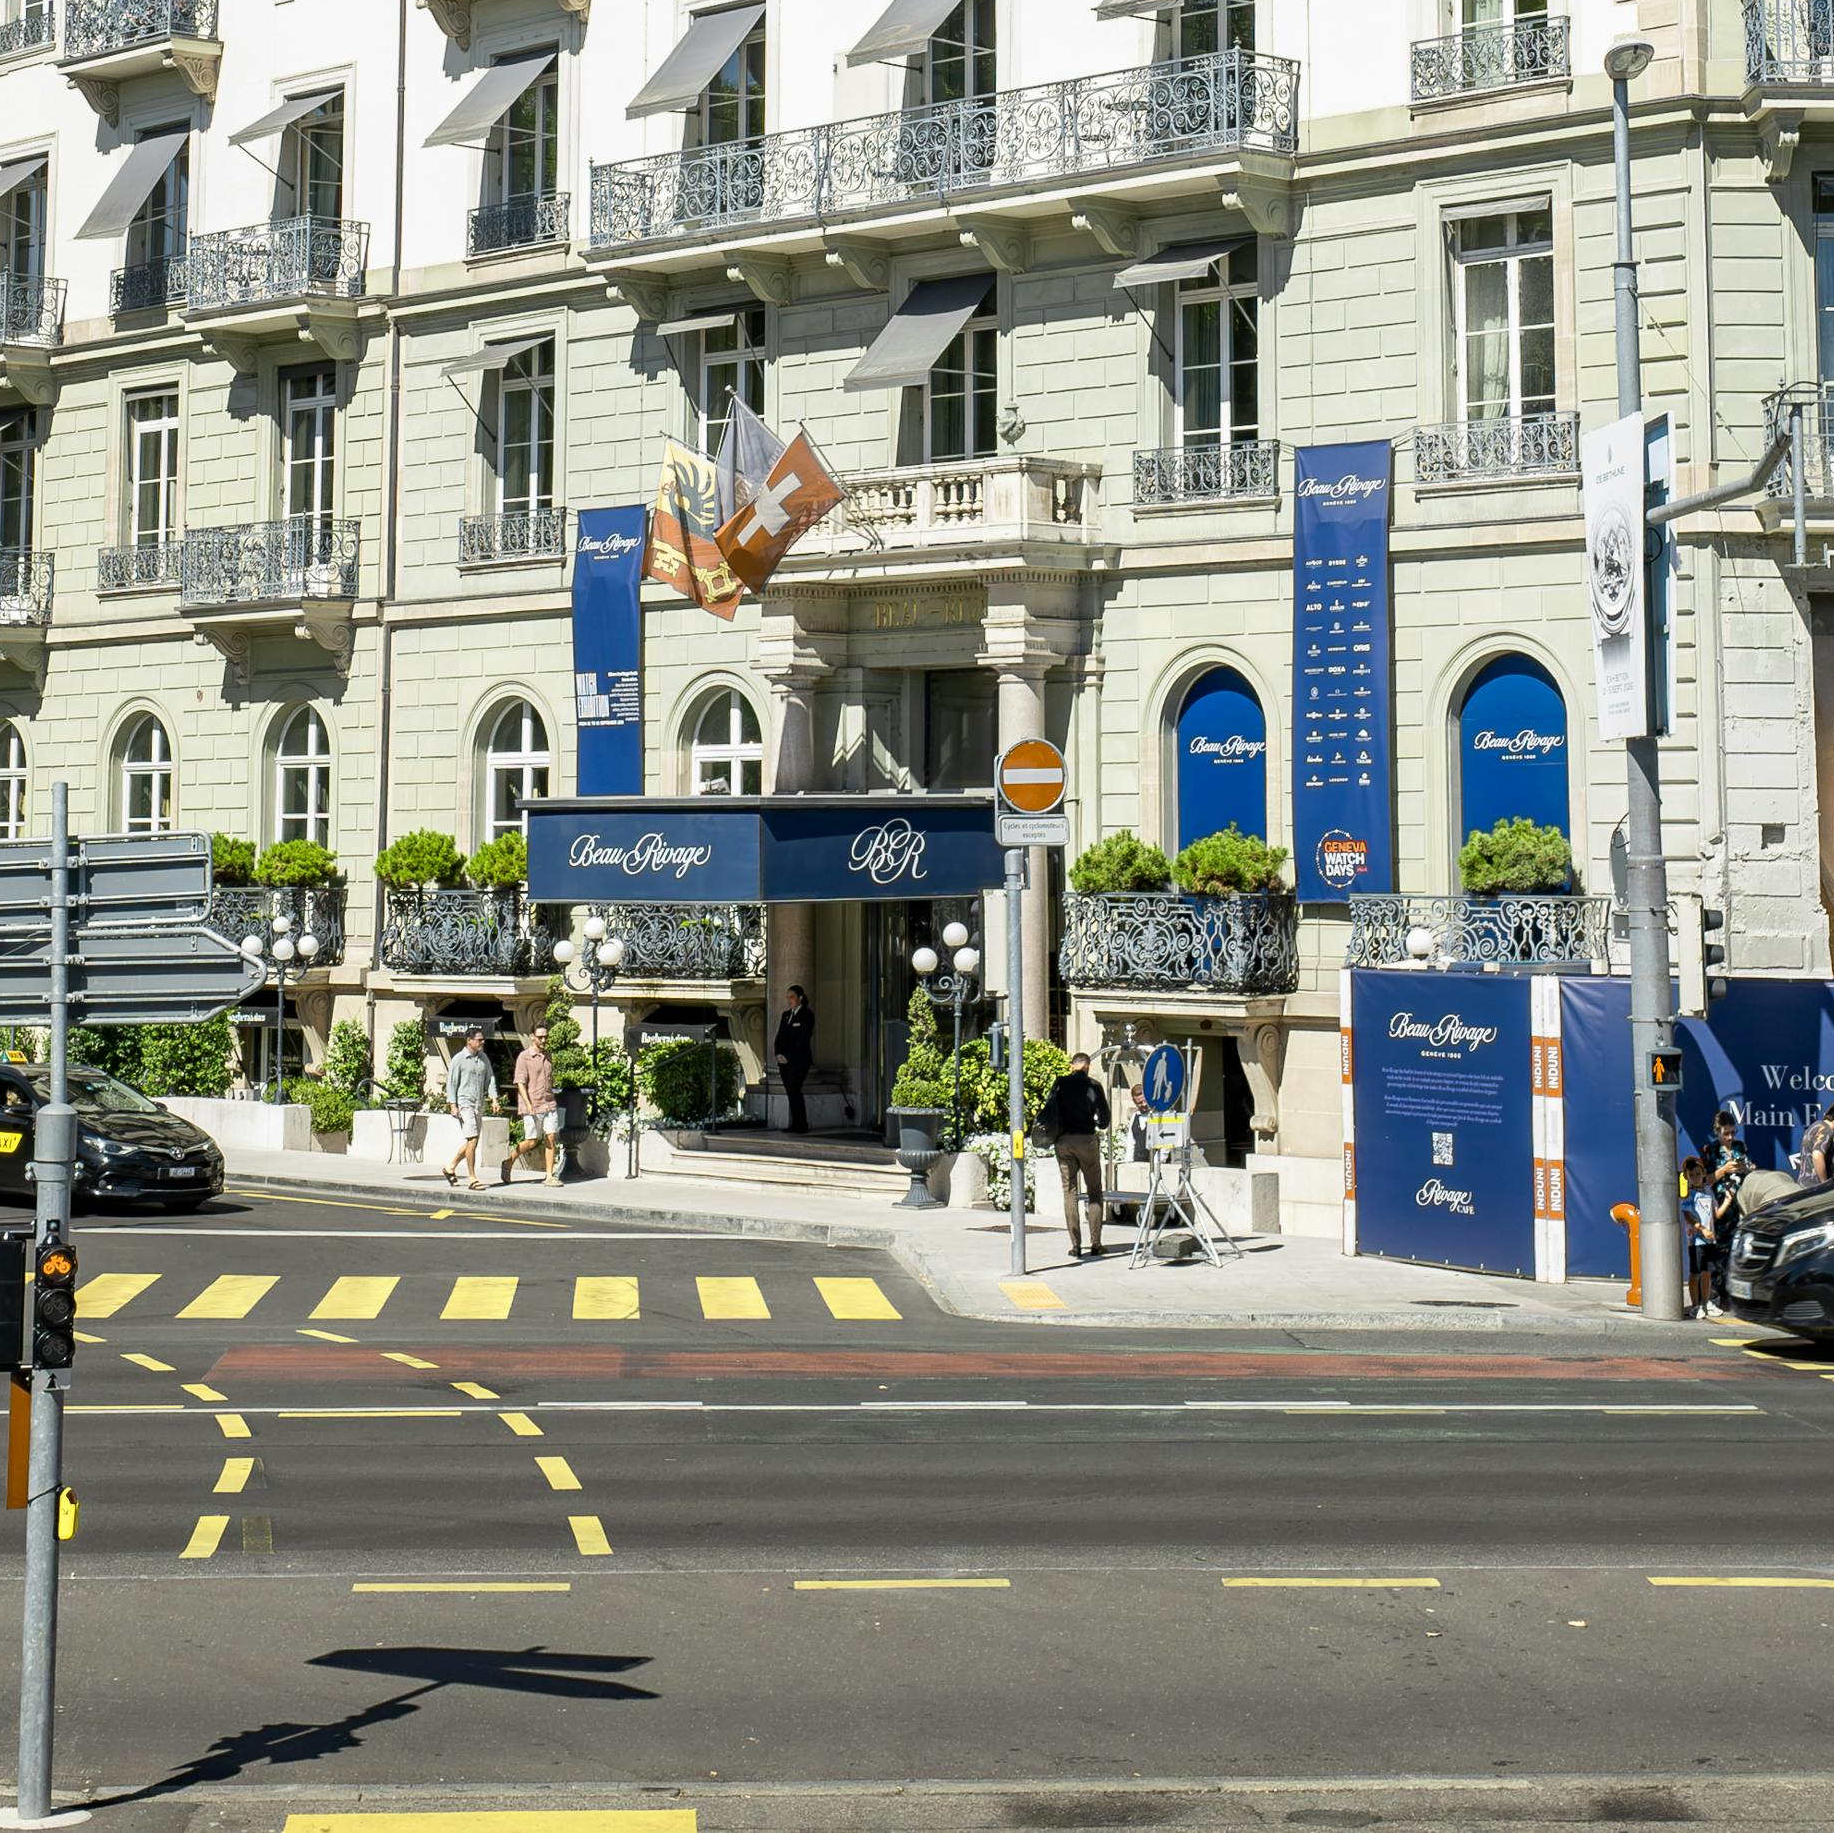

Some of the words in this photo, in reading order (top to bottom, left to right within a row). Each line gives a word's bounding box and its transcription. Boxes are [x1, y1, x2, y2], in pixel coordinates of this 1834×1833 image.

[1298, 478, 1332, 497] Beau
[1330, 474, 1386, 498] Rivage
[1190, 737, 1221, 754] Beau
[1219, 735, 1267, 758] Rivage
[1474, 731, 1510, 749] Beau
[1509, 729, 1565, 754] Rivage
[1004, 822, 1021, 830] Cycles
[569, 834, 626, 867] Beau
[623, 832, 711, 879] Rivage
[1324, 852, 1365, 864] WATCH
[1325, 842, 1367, 852] GENEVA
[1326, 865, 1354, 876] DAYS
[1389, 1012, 1430, 1038] Beau
[1429, 1014, 1497, 1052] Rivage
[1342, 1035, 1350, 1076] INDUNI
[1534, 1046, 1543, 1088] INDUNI
[1547, 1046, 1559, 1089] INDUNI
[1726, 1100, 1795, 1127] Main
[1344, 1149, 1352, 1190] INDUNI
[1415, 1178, 1472, 1213] Rivage
[1536, 1167, 1545, 1210] INDUNI
[1550, 1168, 1561, 1212] INDUNI
[1457, 1203, 1475, 1215] CAFÉ
